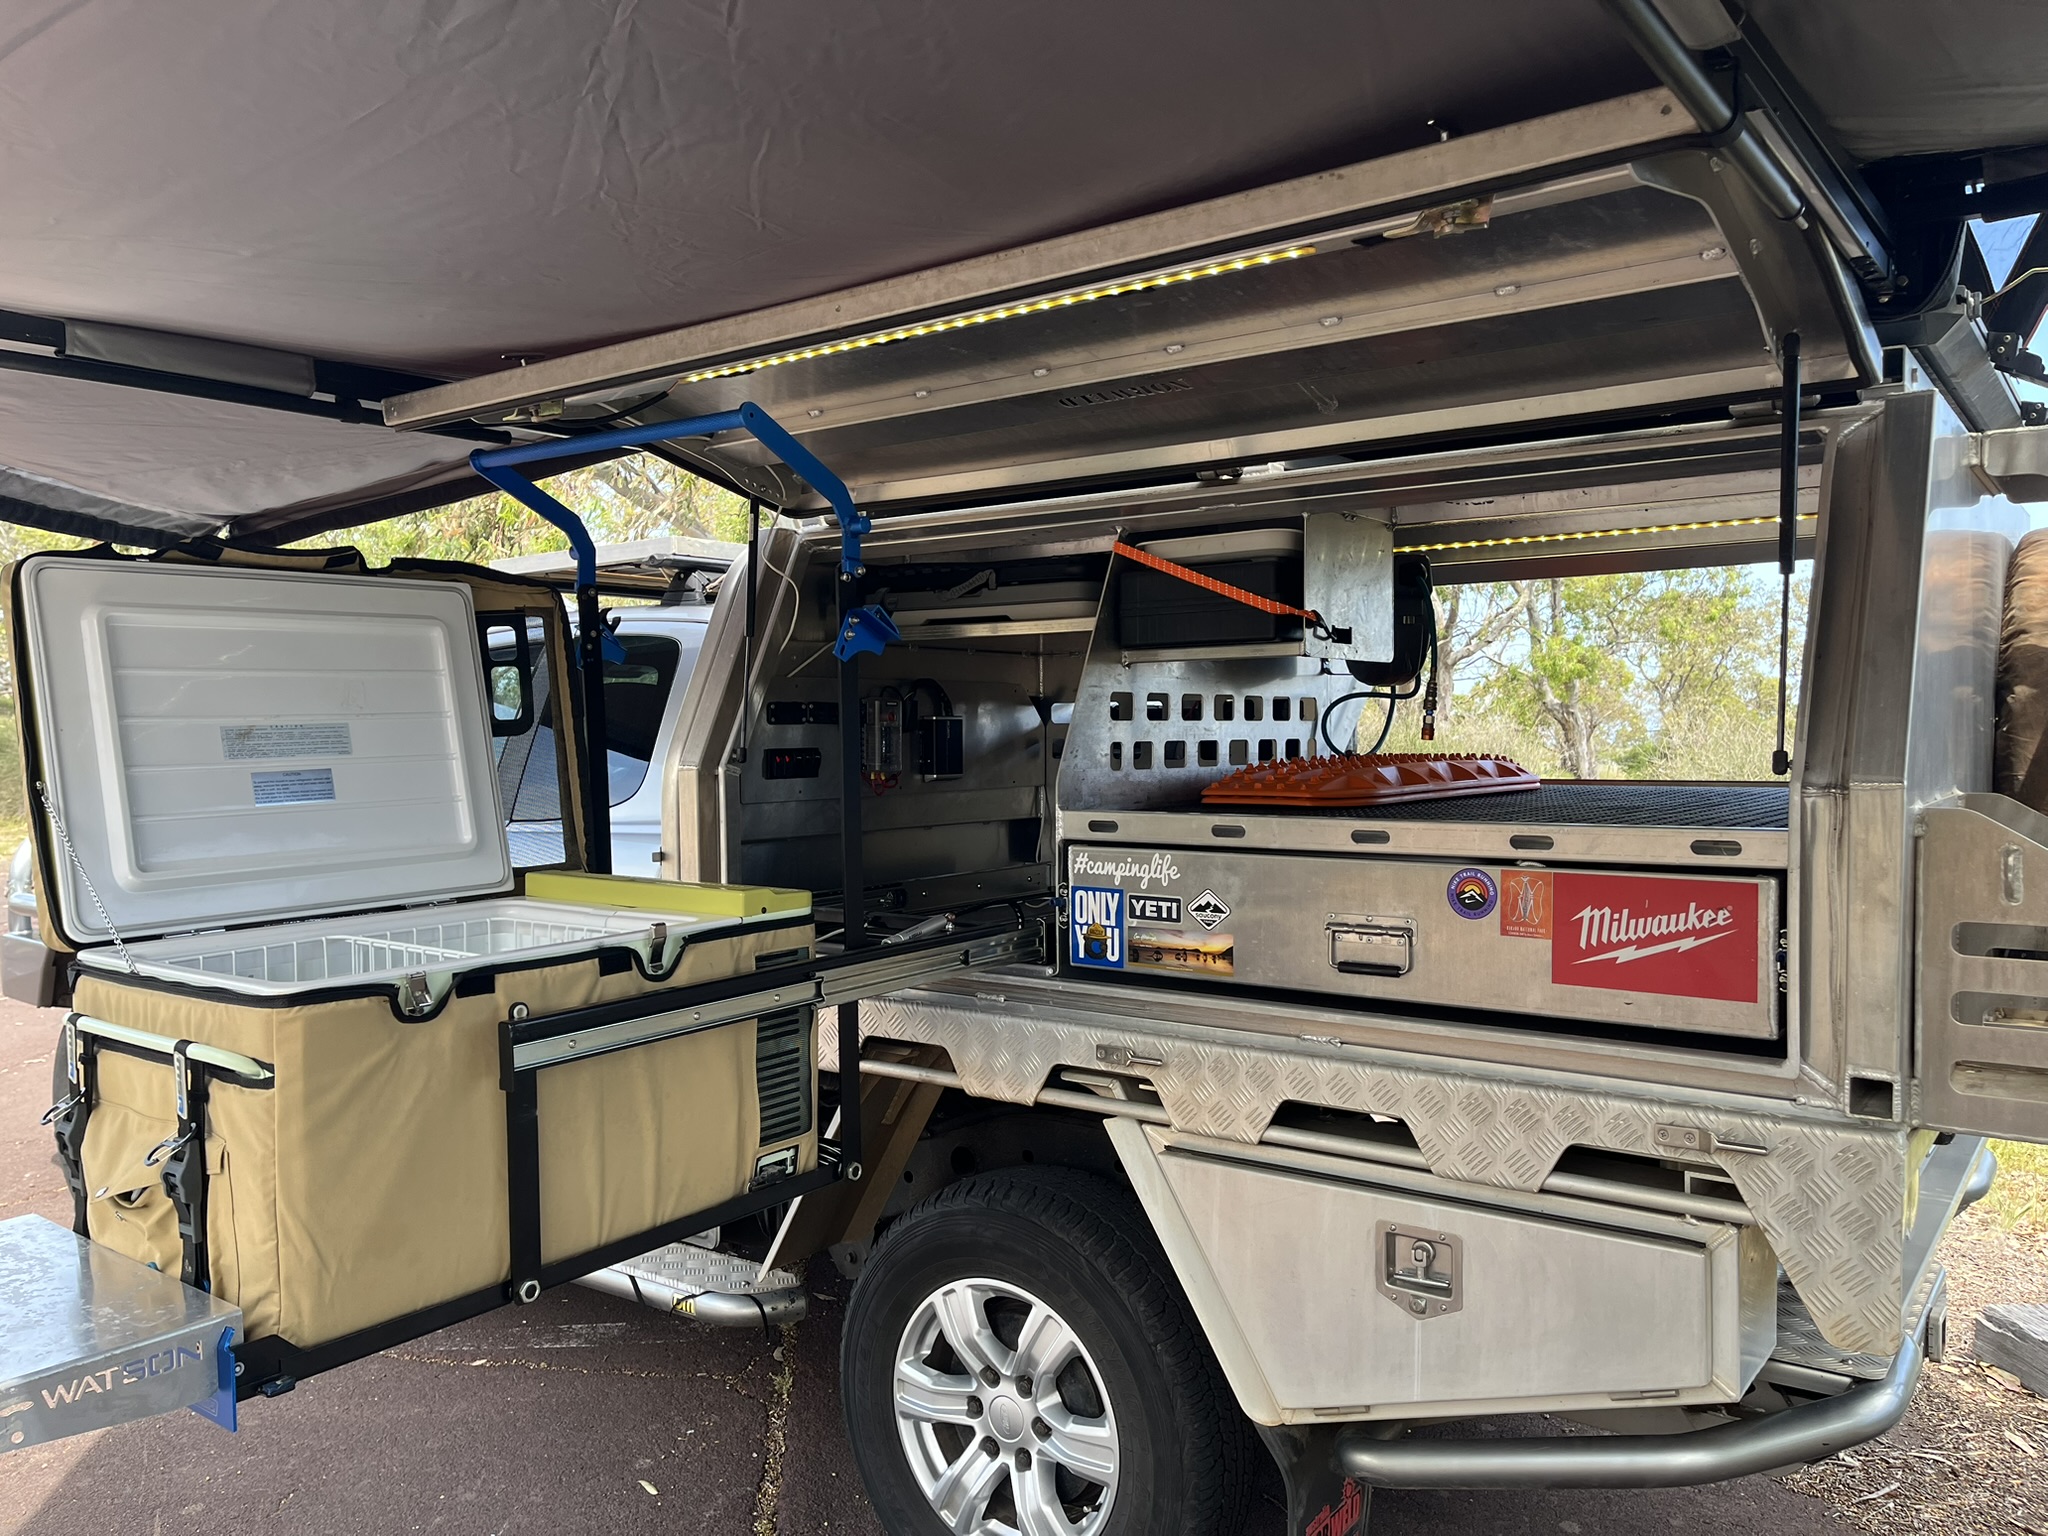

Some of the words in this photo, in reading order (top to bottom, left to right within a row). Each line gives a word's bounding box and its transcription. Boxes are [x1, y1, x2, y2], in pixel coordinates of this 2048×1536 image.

[1074, 852, 1181, 890] #campinglife
[1450, 878, 1460, 890] NIKE
[1477, 873, 1495, 896] RUNNING
[1075, 889, 1120, 927] ONLY
[1130, 899, 1178, 919] YETI
[1195, 912, 1222, 921] saucony
[1570, 902, 1733, 950] Milwaukee
[41, 1340, 203, 1409] WATSON
